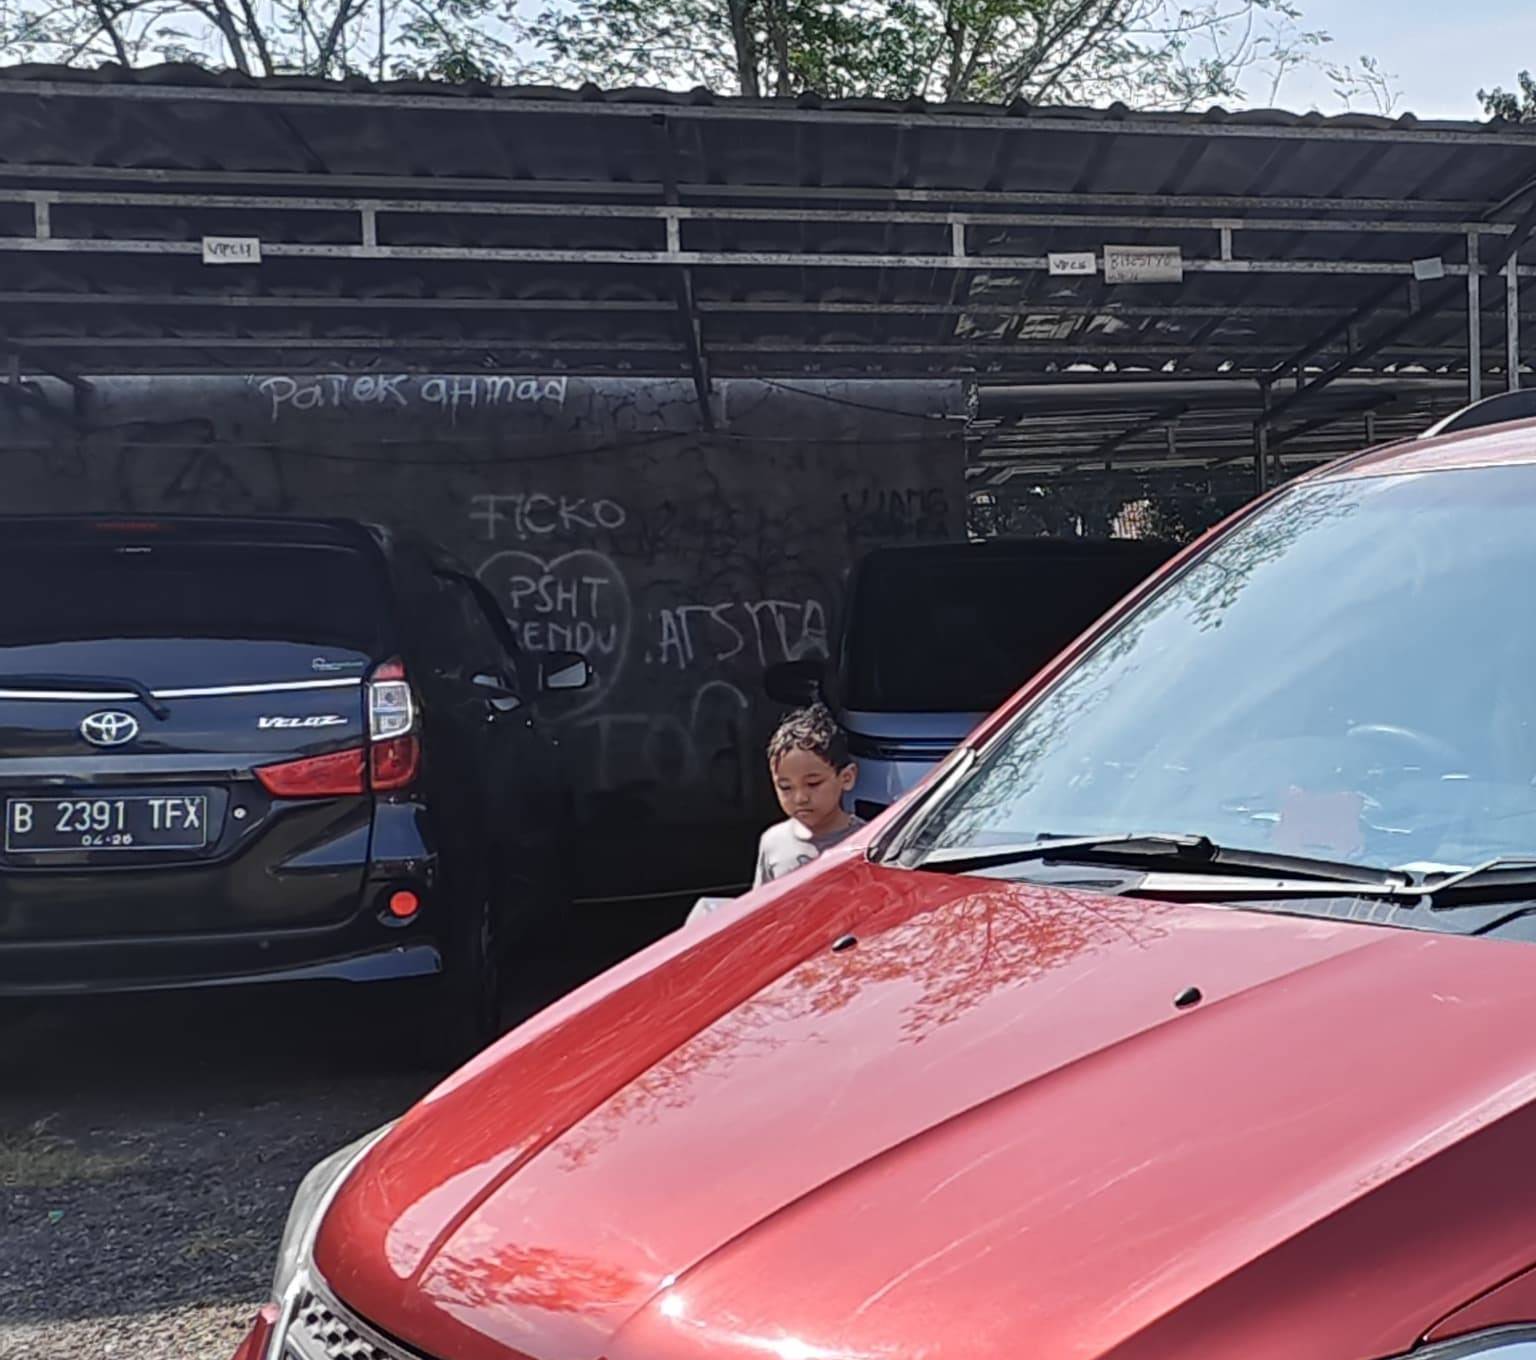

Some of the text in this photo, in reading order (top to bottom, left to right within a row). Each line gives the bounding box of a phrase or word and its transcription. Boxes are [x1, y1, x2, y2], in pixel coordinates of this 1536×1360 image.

[510, 574, 609, 619] PSHT
[258, 714, 349, 729] VELOZ
[14, 797, 201, 833] B 2391 TFX
